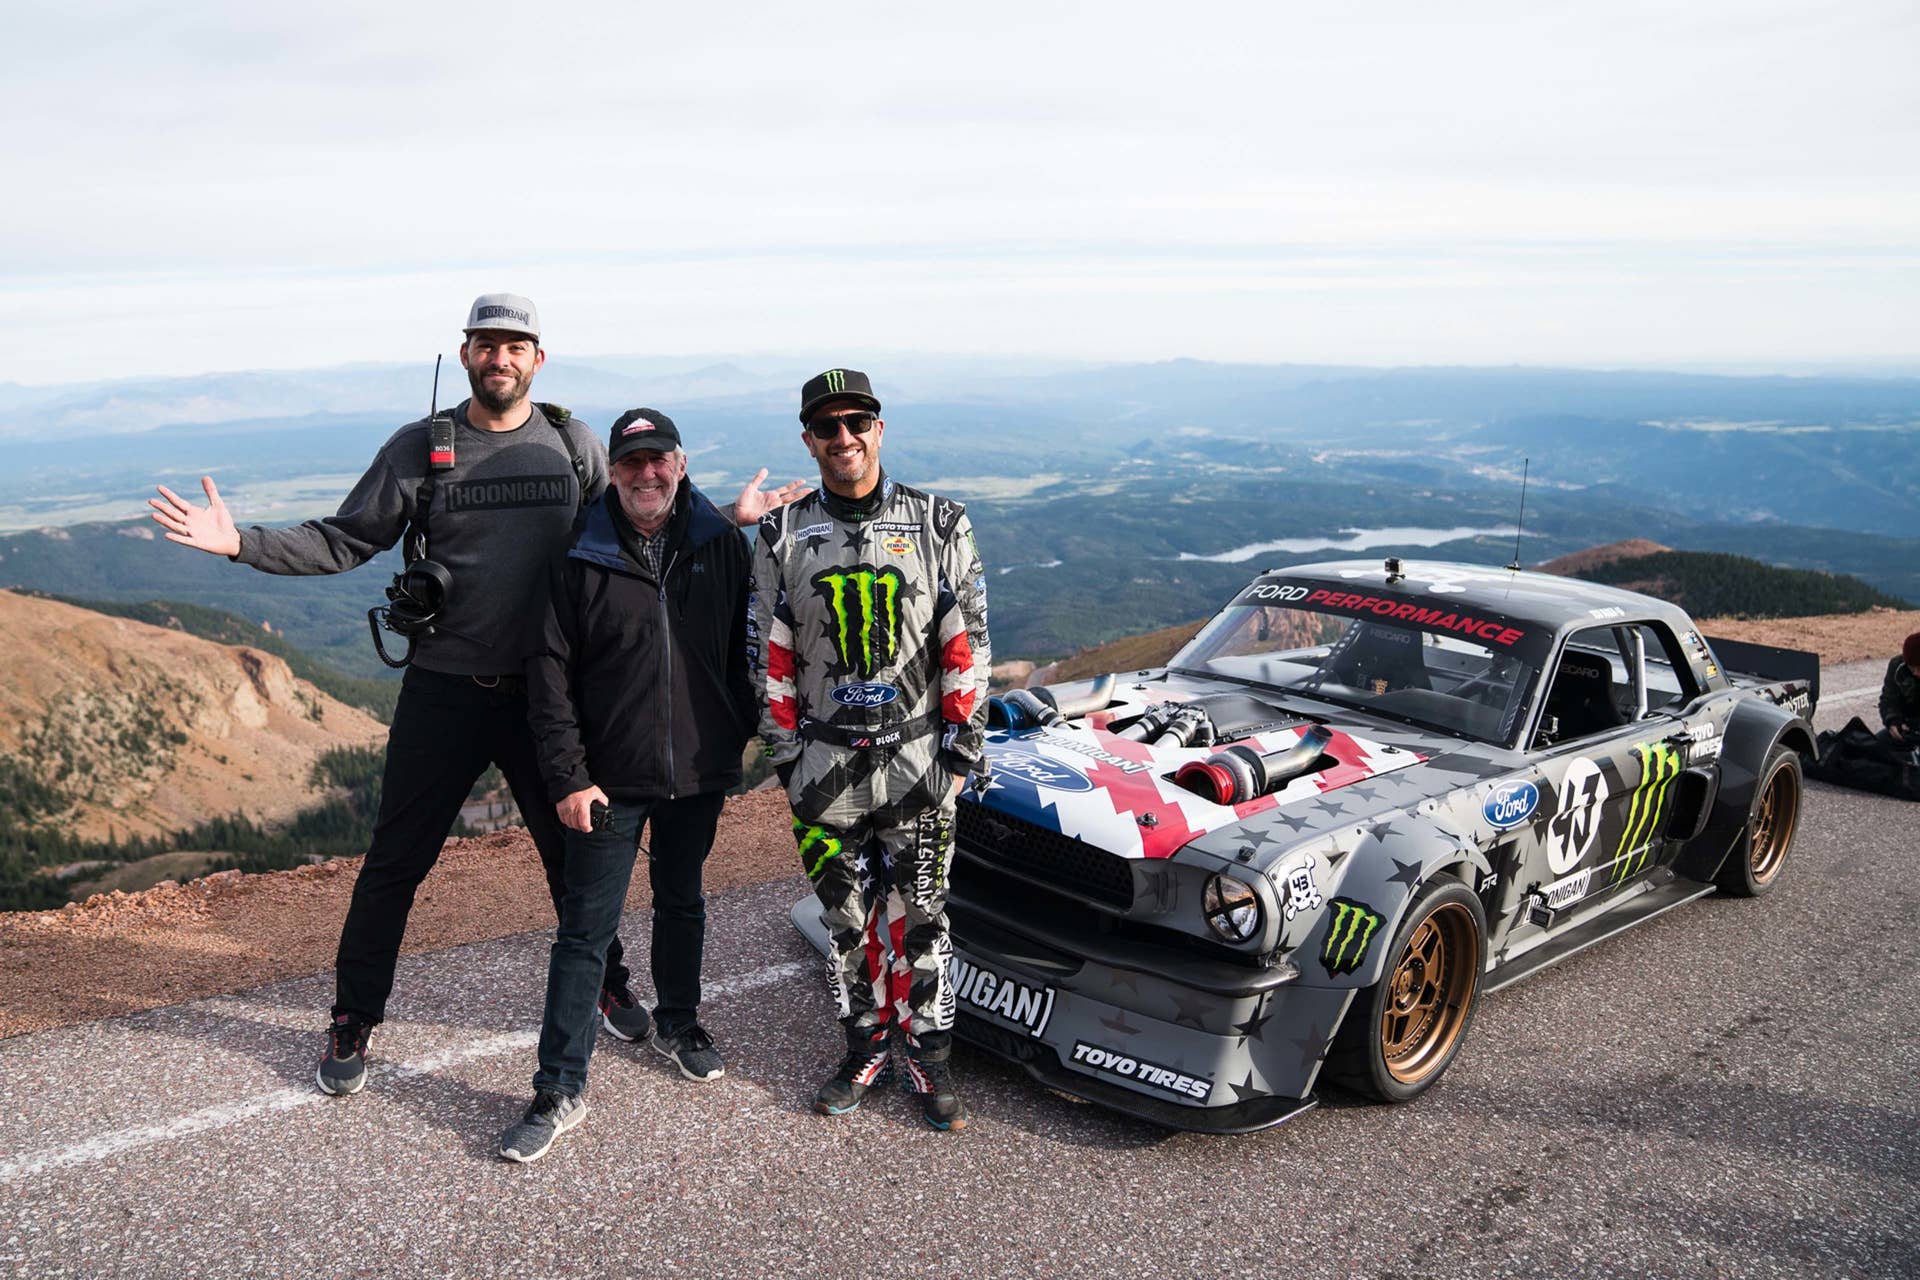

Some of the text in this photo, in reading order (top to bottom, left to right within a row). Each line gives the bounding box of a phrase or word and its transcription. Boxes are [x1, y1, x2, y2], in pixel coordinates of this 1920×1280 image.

[873, 524, 922, 532] TOYO TIRES
[1245, 582, 1525, 647] FORD PERFORMANCE
[1560, 663, 1600, 679] ECARO
[843, 686, 885, 703] Ford
[875, 731, 901, 746] BLOCK
[990, 751, 1071, 783] Ford
[1494, 785, 1529, 820] Ford
[914, 807, 939, 907] MONSTER
[1291, 873, 1309, 892] 43
[1073, 1043, 1211, 1100] TOYO TIRES
